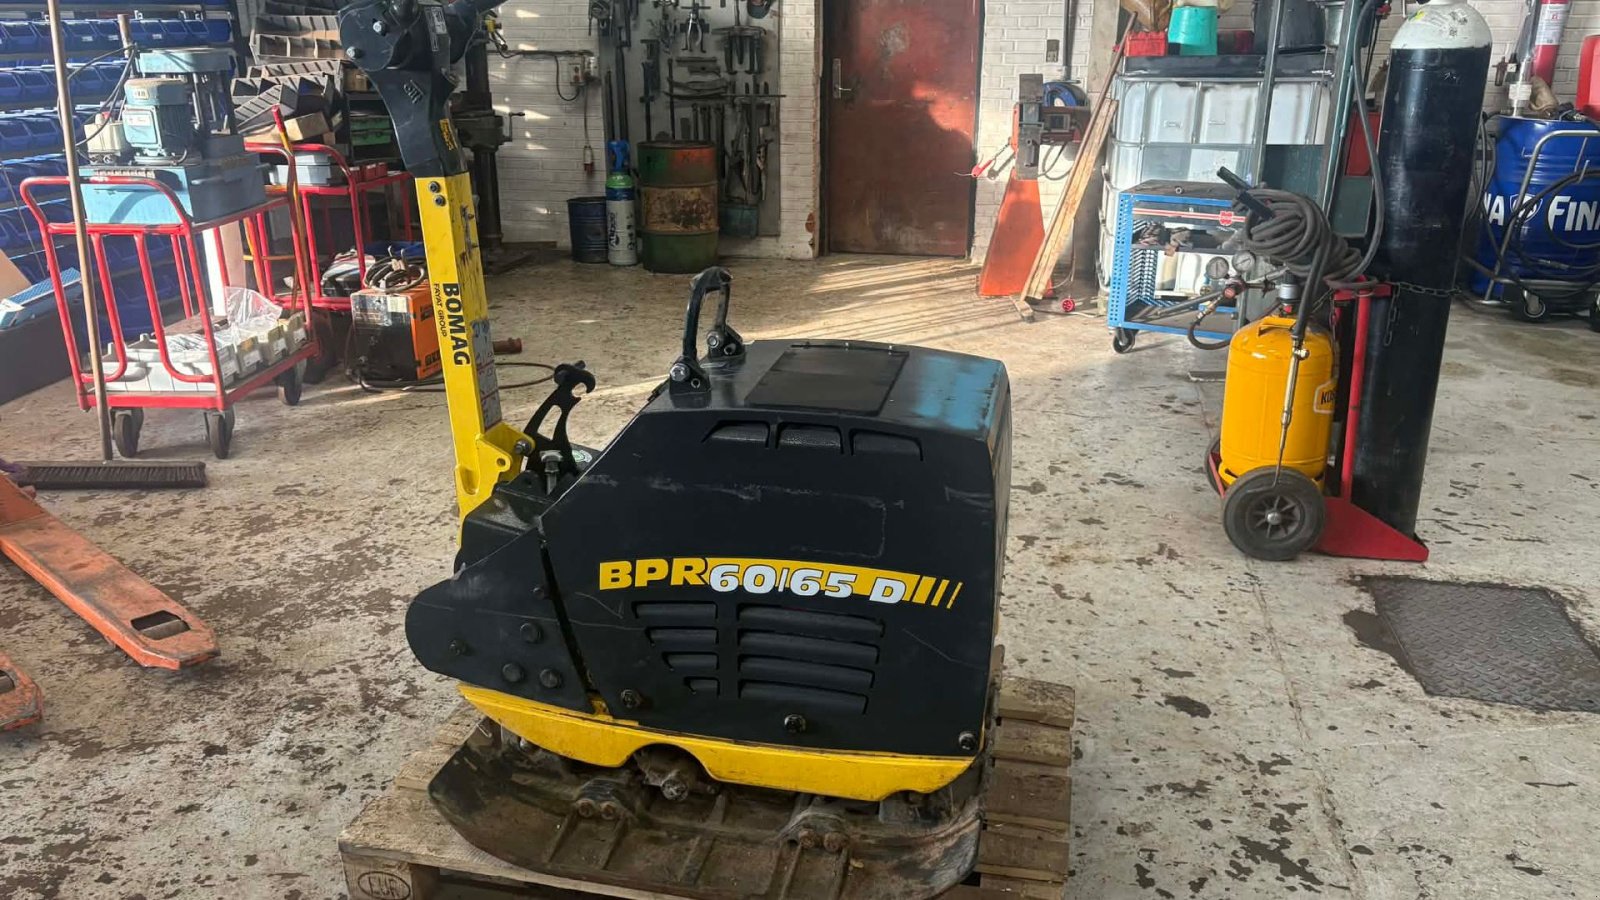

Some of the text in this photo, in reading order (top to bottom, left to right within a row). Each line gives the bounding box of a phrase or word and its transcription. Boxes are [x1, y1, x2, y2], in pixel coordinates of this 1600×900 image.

[1548, 196, 1600, 231] FIN
[433, 283, 448, 337] FAYAT GROUP
[442, 283, 471, 366] BOMAG
[869, 577, 907, 604] D
